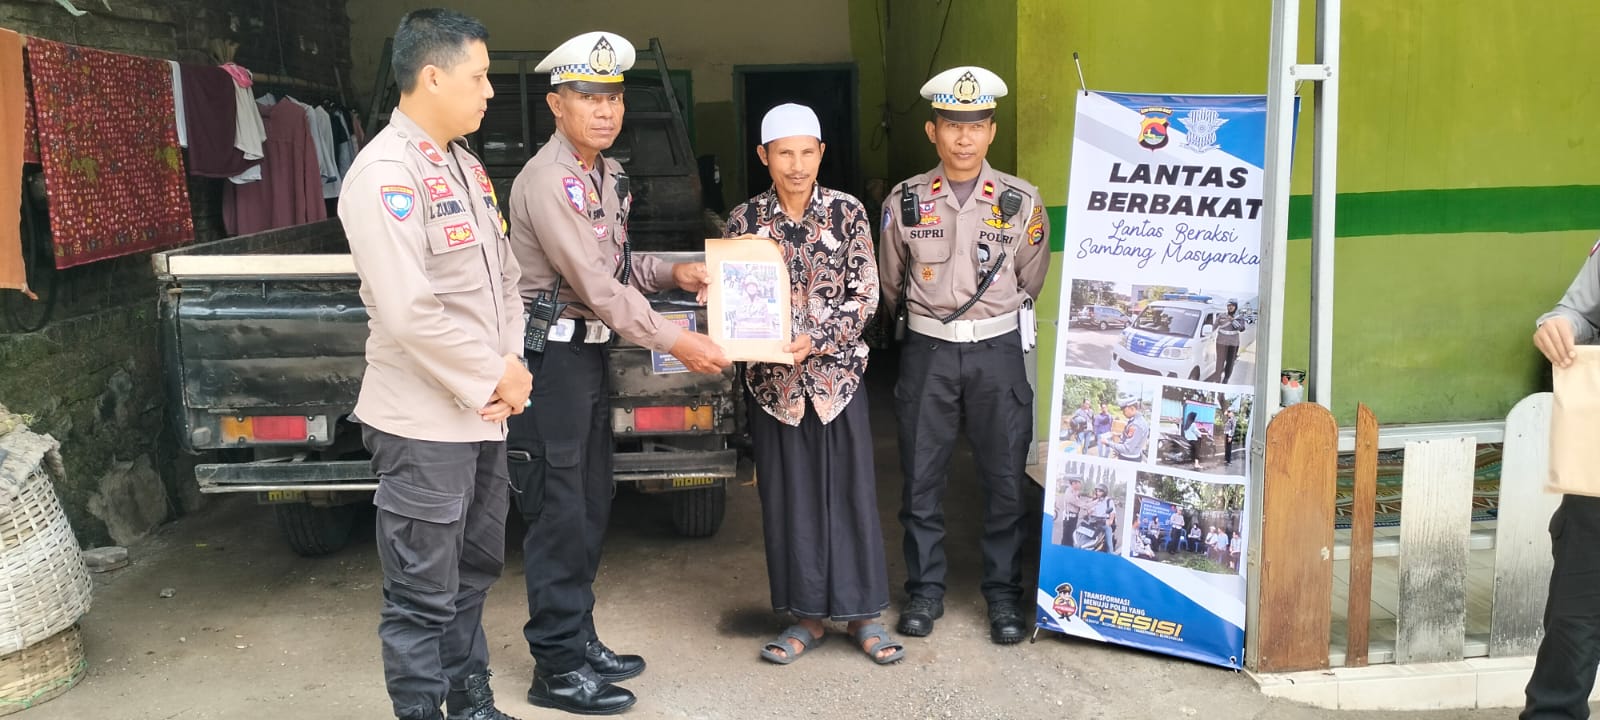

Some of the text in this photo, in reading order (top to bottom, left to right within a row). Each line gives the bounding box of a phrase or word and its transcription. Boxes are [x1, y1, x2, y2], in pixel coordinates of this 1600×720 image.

[1108, 162, 1249, 188] LANTAS
[1086, 190, 1263, 220] BERBAKAT
[909, 229, 945, 239] SUPRI
[979, 230, 1014, 244] POLRI
[1107, 218, 1239, 246] Lantas Beraksi
[1076, 238, 1261, 271] Sambang Masyaraka
[1084, 591, 1131, 606] TRANSFORMASI
[1084, 599, 1110, 609] MENUJU
[1109, 602, 1128, 612] POLRI
[1128, 606, 1146, 616] YANG
[1082, 605, 1183, 637] PRESISI
